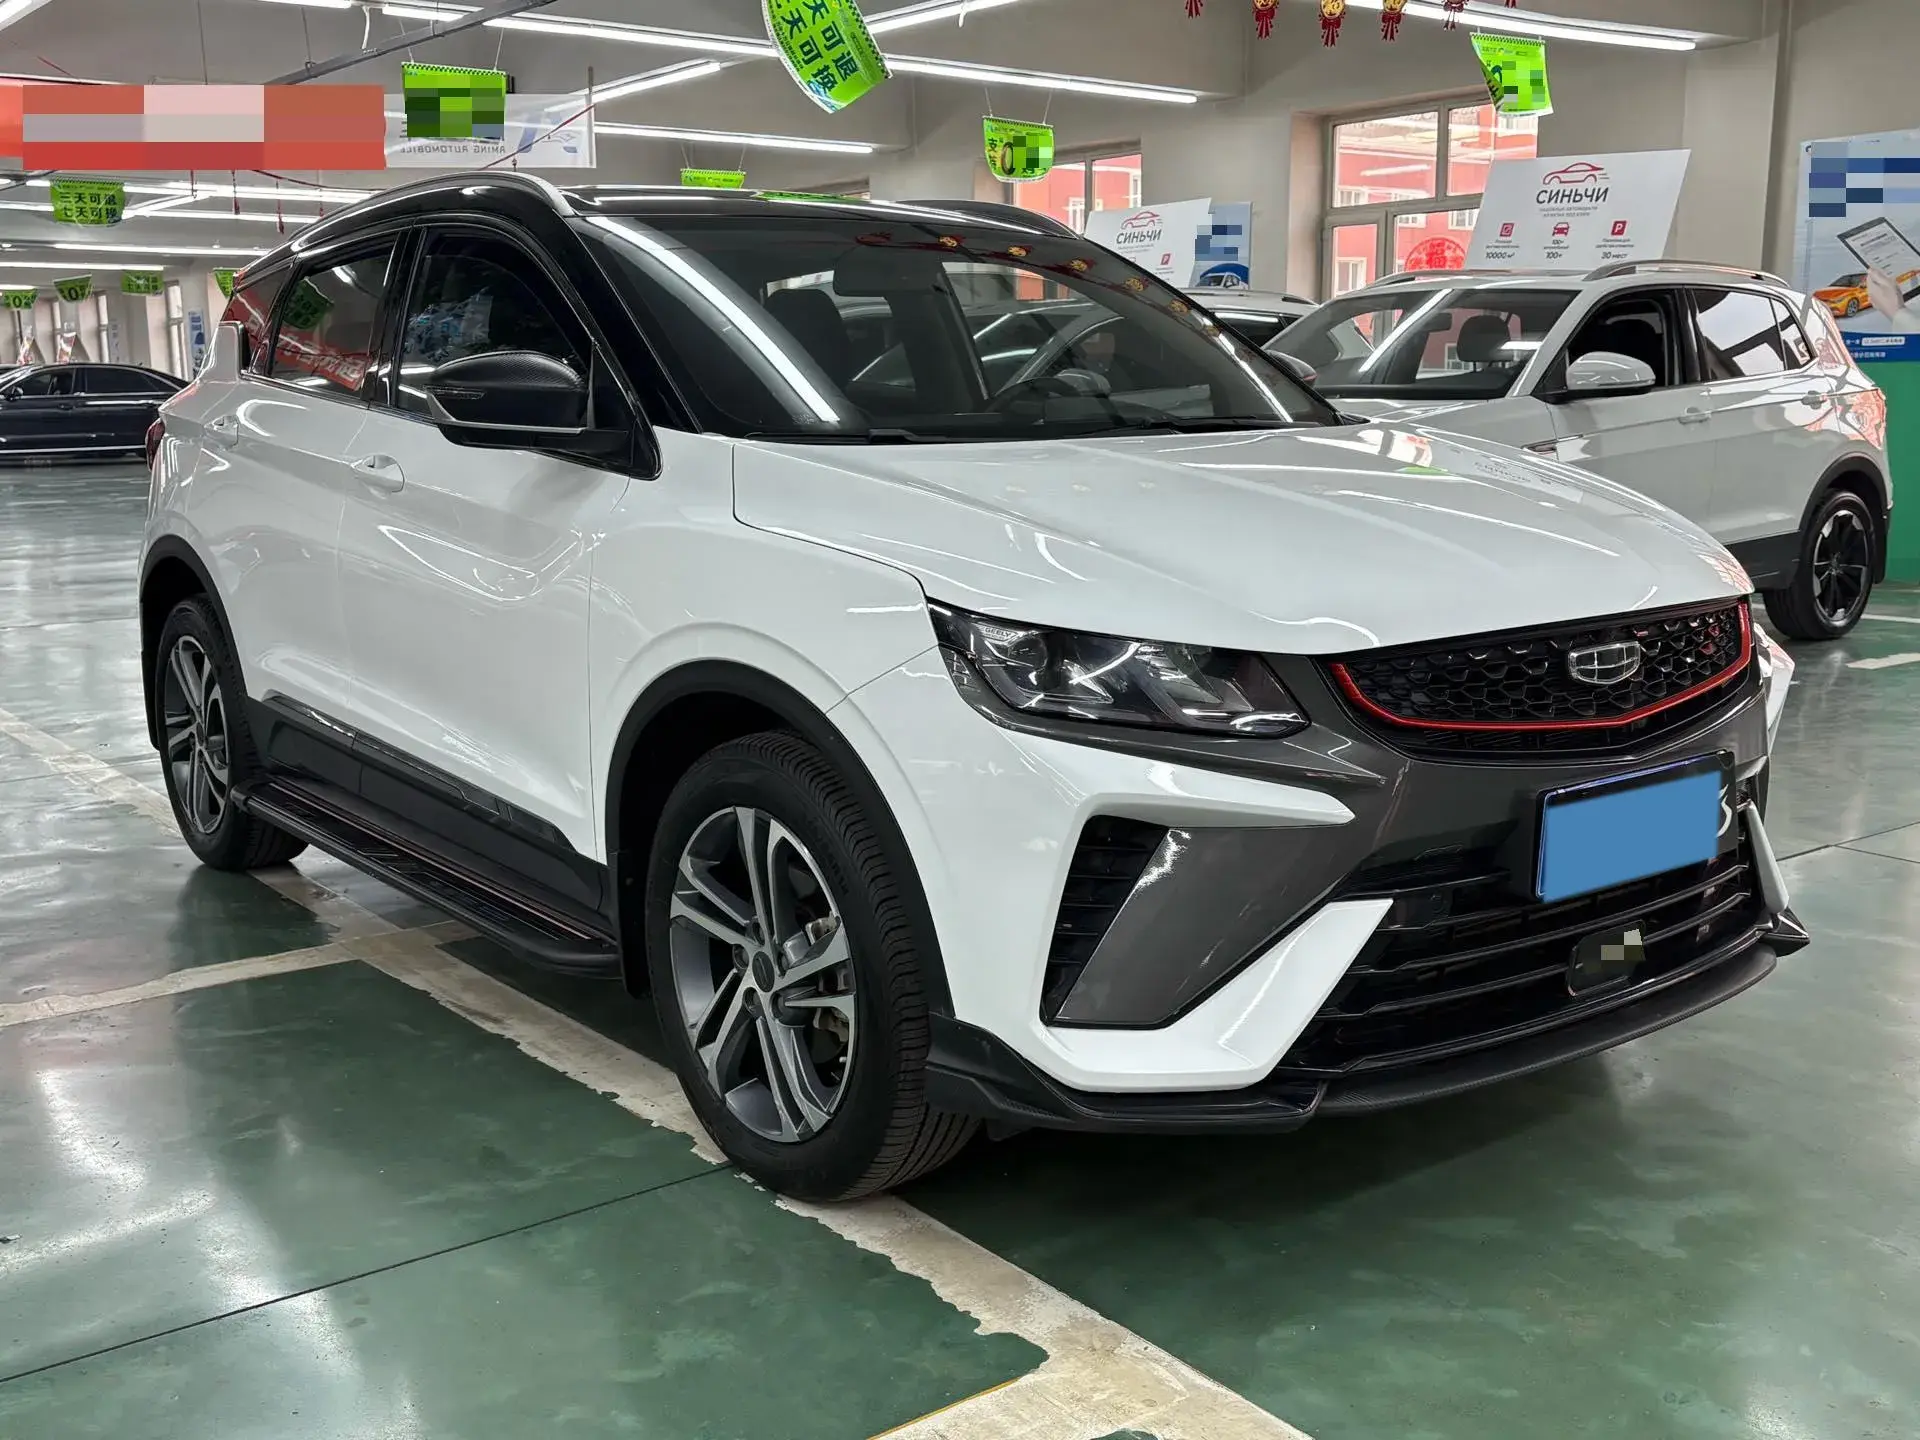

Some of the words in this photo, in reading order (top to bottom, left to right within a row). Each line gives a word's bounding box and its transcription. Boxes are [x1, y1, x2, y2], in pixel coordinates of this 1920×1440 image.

[775, 0, 838, 93] 天可换
[1536, 187, 1608, 204] СИНЬЧИ
[1116, 229, 1162, 244] СИНЬЧИ
